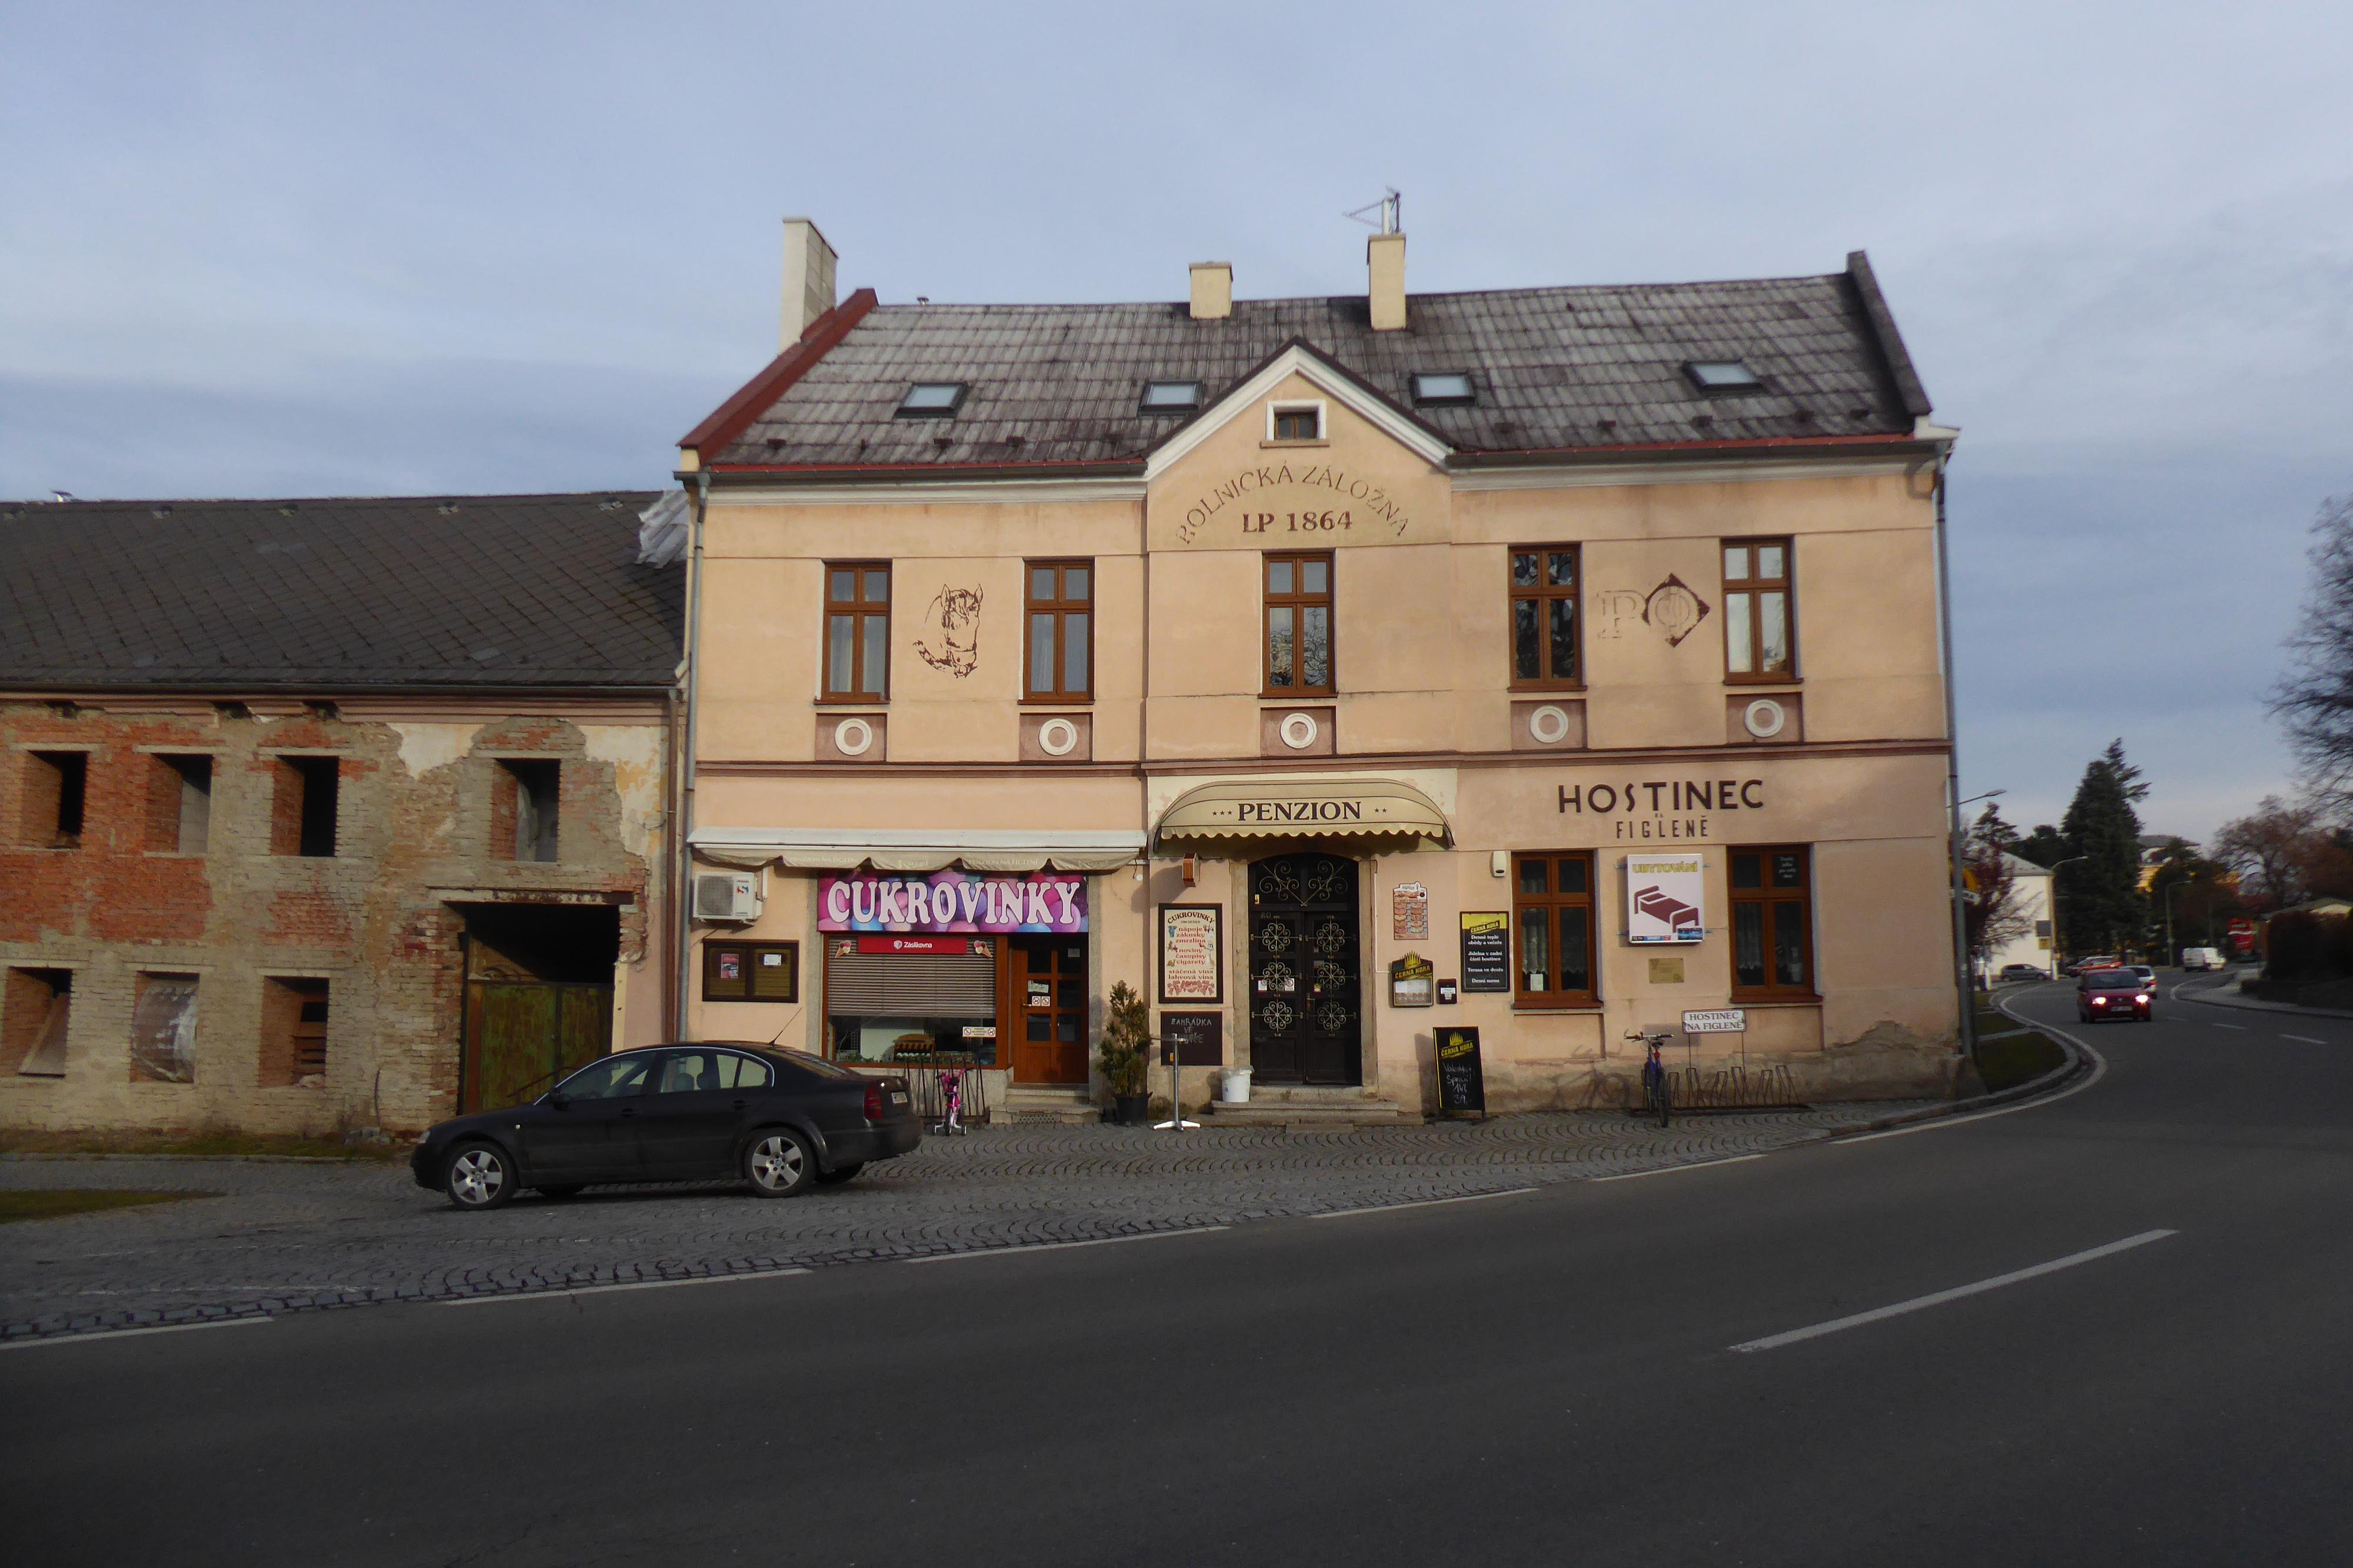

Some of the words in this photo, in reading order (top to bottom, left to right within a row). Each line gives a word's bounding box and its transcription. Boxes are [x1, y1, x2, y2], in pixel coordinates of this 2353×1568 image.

[1176, 461, 1294, 545] ROLNICKÁ
[1302, 465, 1409, 536] ZÁLOŽNA
[1242, 513, 1275, 533] LP
[1287, 510, 1353, 532] 1864
[1558, 779, 1764, 813] HOSTINEC
[1238, 801, 1361, 821] PENZION
[1616, 815, 1708, 839] FIGLENĚ
[1632, 860, 1698, 873] UBYTOVÁNÍ
[827, 880, 1080, 924] CUKROVINKY
[1168, 912, 1215, 924] CUKROVINKY
[1415, 965, 1431, 975] HORA
[1171, 1017, 1212, 1026] ZAHRÁDKA
[1690, 1012, 1738, 1020] HOSTINEC
[1704, 1020, 1742, 1030] FIGLENĚ
[1441, 1046, 1459, 1056] ČERNÁ
[1459, 1042, 1474, 1050] HORA
